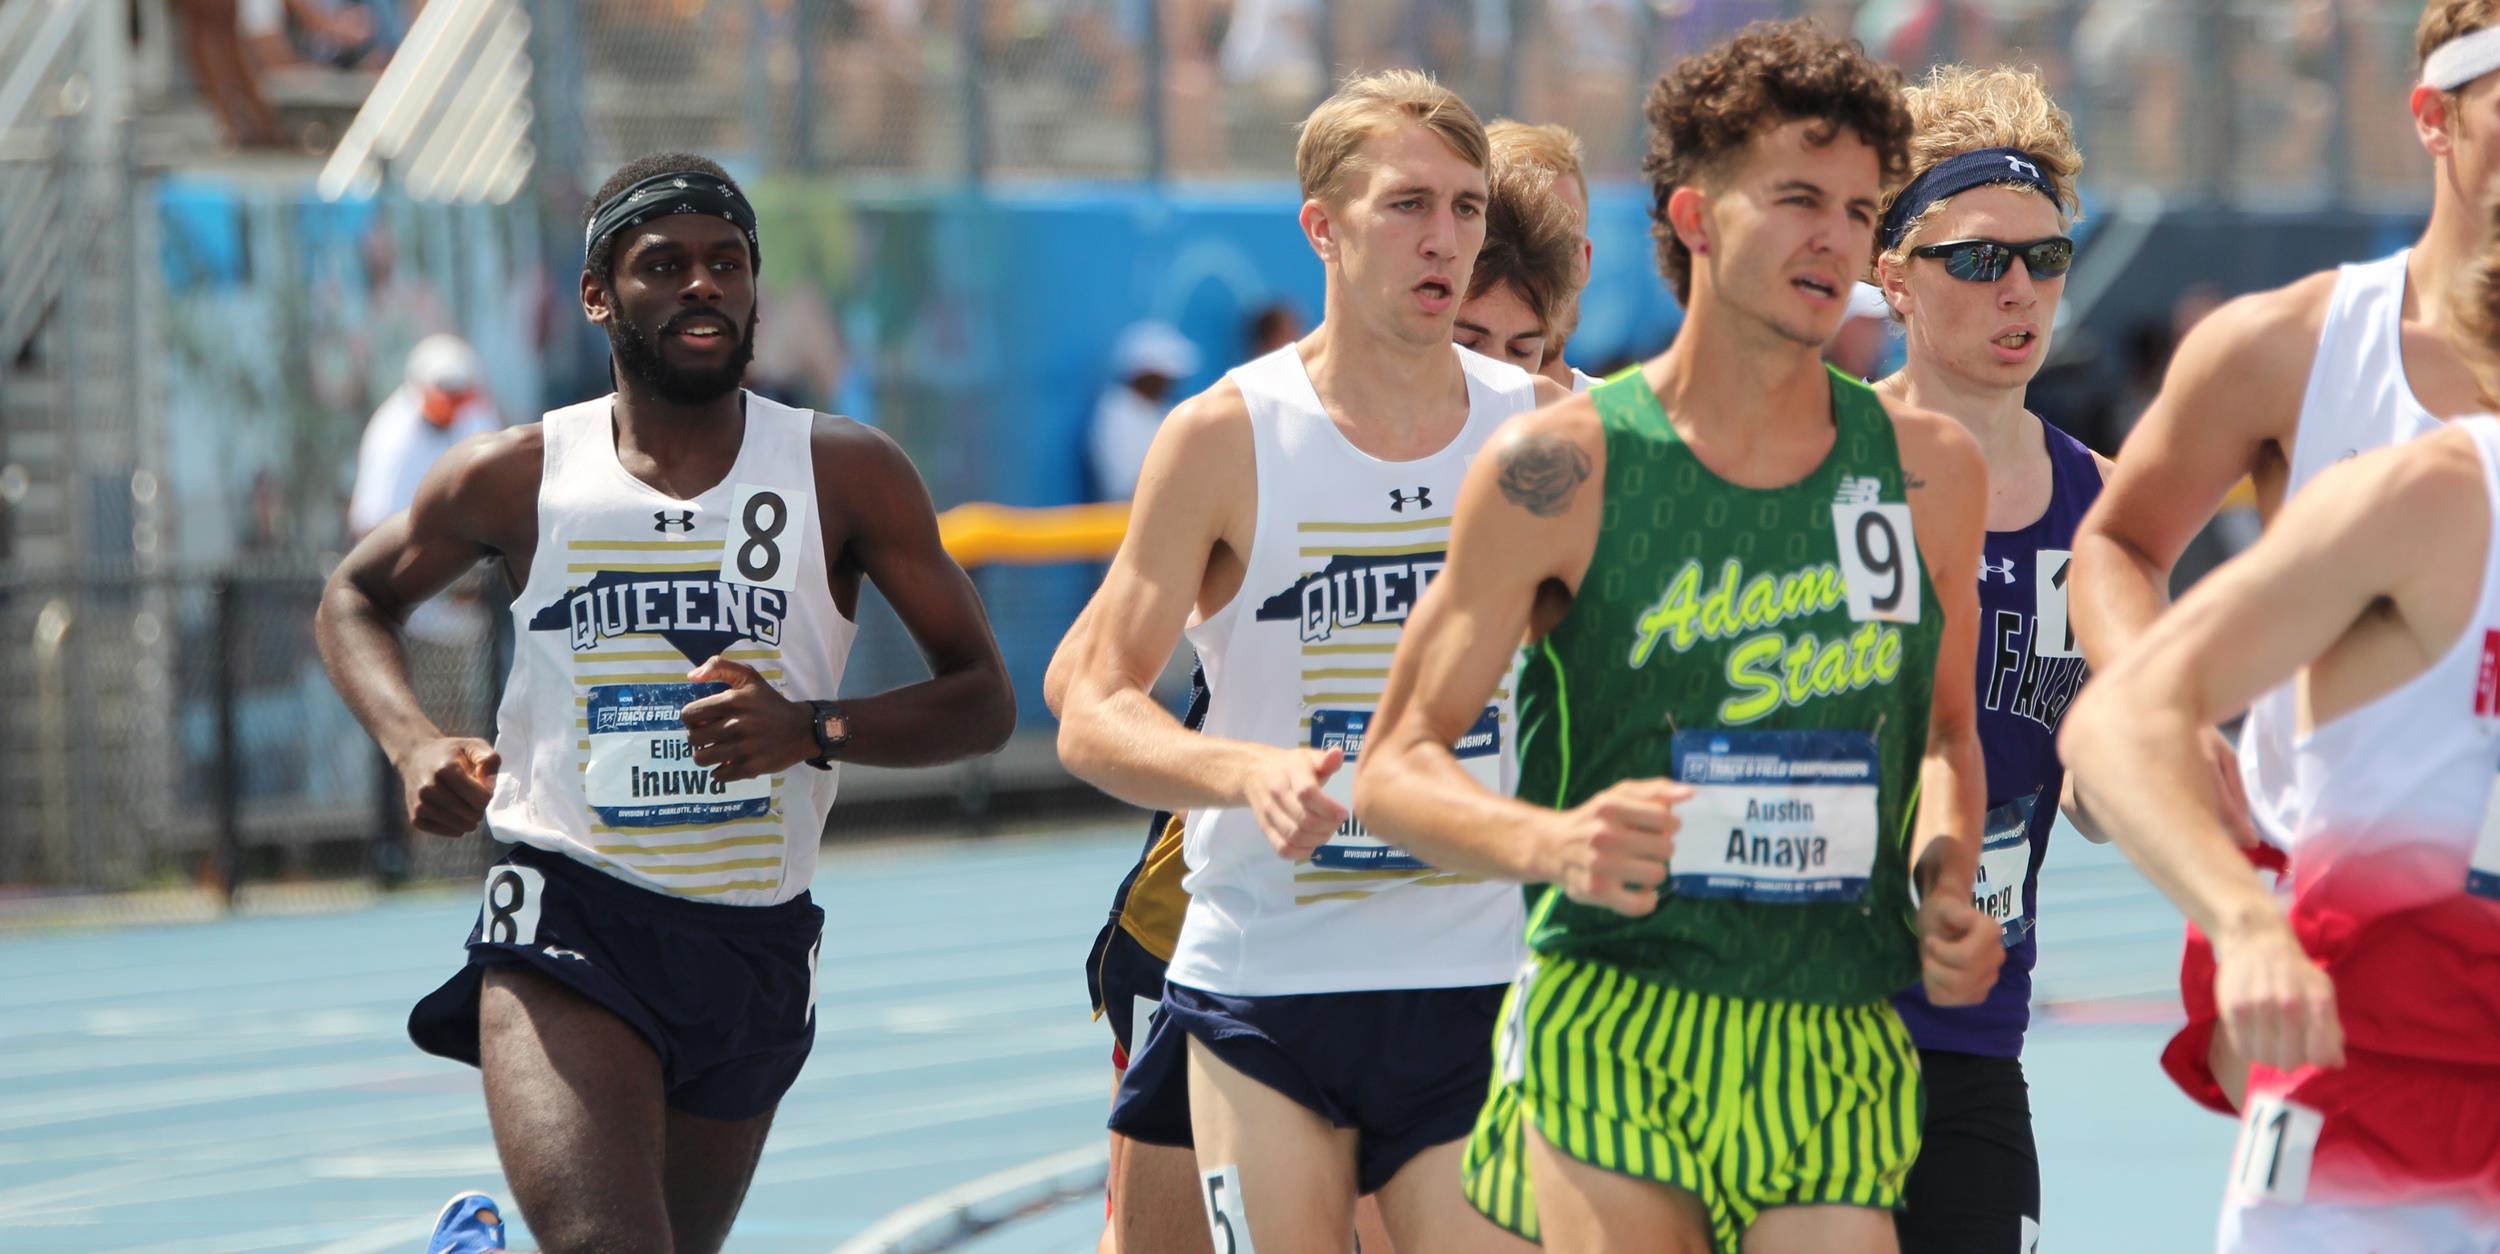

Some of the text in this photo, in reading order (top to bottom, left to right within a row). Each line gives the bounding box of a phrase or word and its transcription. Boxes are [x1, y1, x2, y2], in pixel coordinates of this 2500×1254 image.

[737, 490, 787, 582] 8
[1856, 510, 1903, 612] 9
[570, 580, 781, 650] QUEENS
[1629, 554, 1849, 668] Adam
[1718, 621, 1901, 725] State
[616, 711, 644, 722] TRACK
[654, 710, 681, 721] FIELD
[651, 739, 693, 761] Elija
[632, 766, 726, 798] Inuwa
[1746, 798, 1814, 822] Austin
[1344, 850, 1370, 858] DIVISION
[1725, 828, 1828, 873] Anaya
[489, 870, 524, 943] 8
[1207, 1175, 1237, 1254] 5
